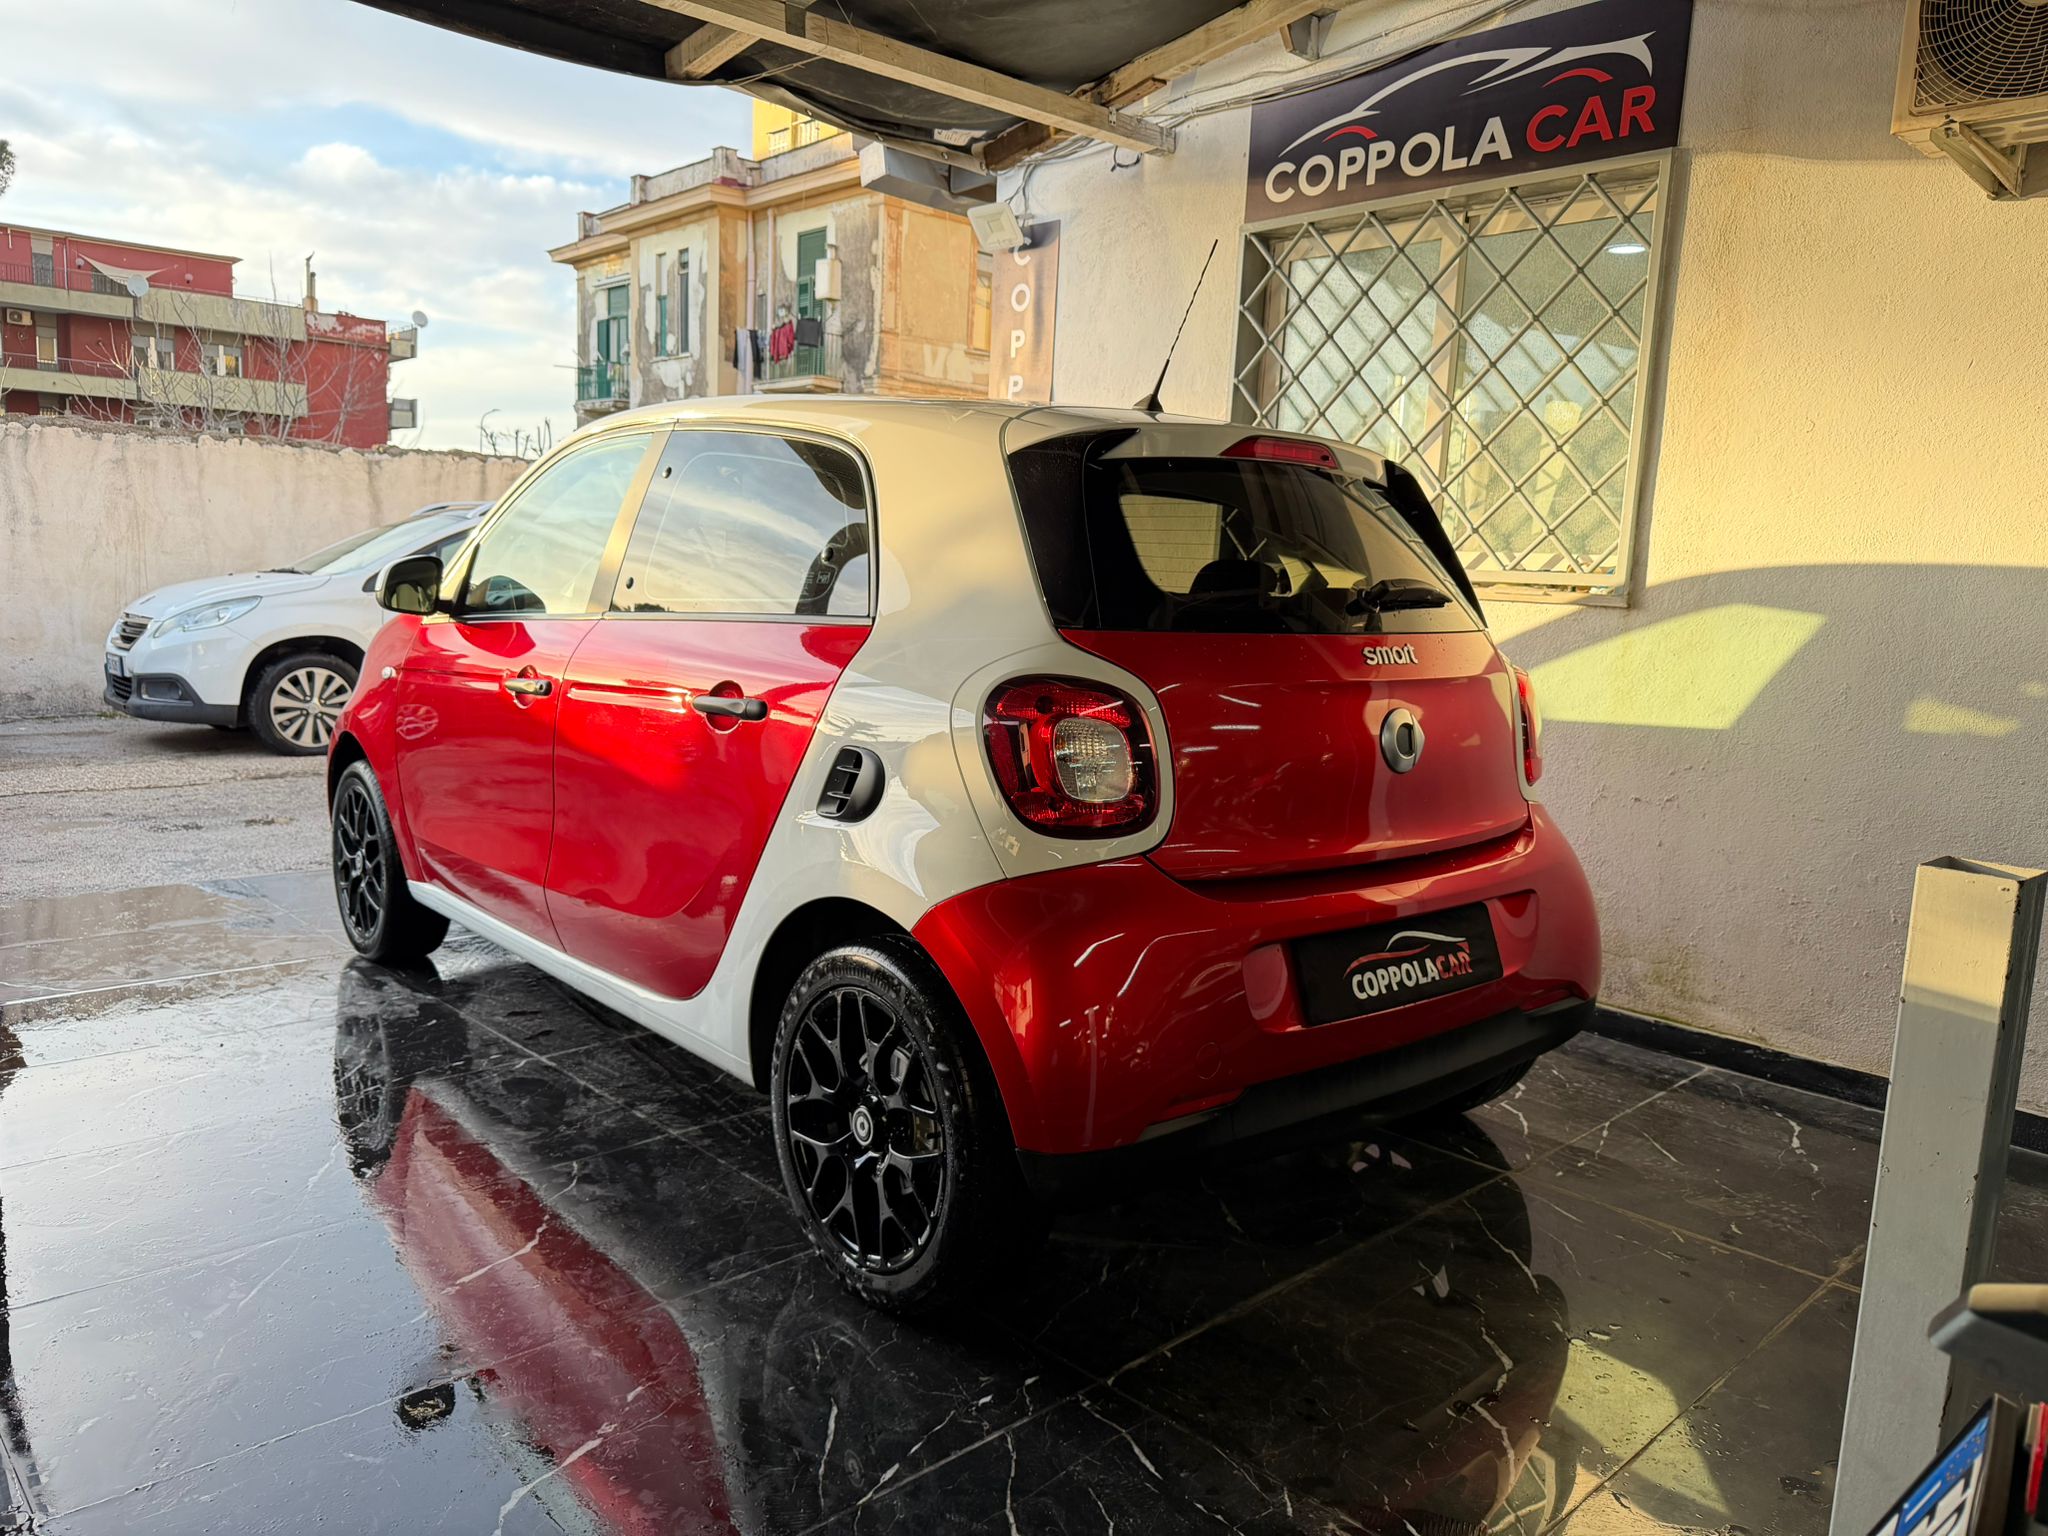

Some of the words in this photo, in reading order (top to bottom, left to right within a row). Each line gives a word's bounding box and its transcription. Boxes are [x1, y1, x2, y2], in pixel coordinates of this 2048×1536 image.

[1265, 116, 1512, 203] COPPOLA
[1526, 85, 1656, 152] CAR
[1363, 643, 1419, 666] smart
